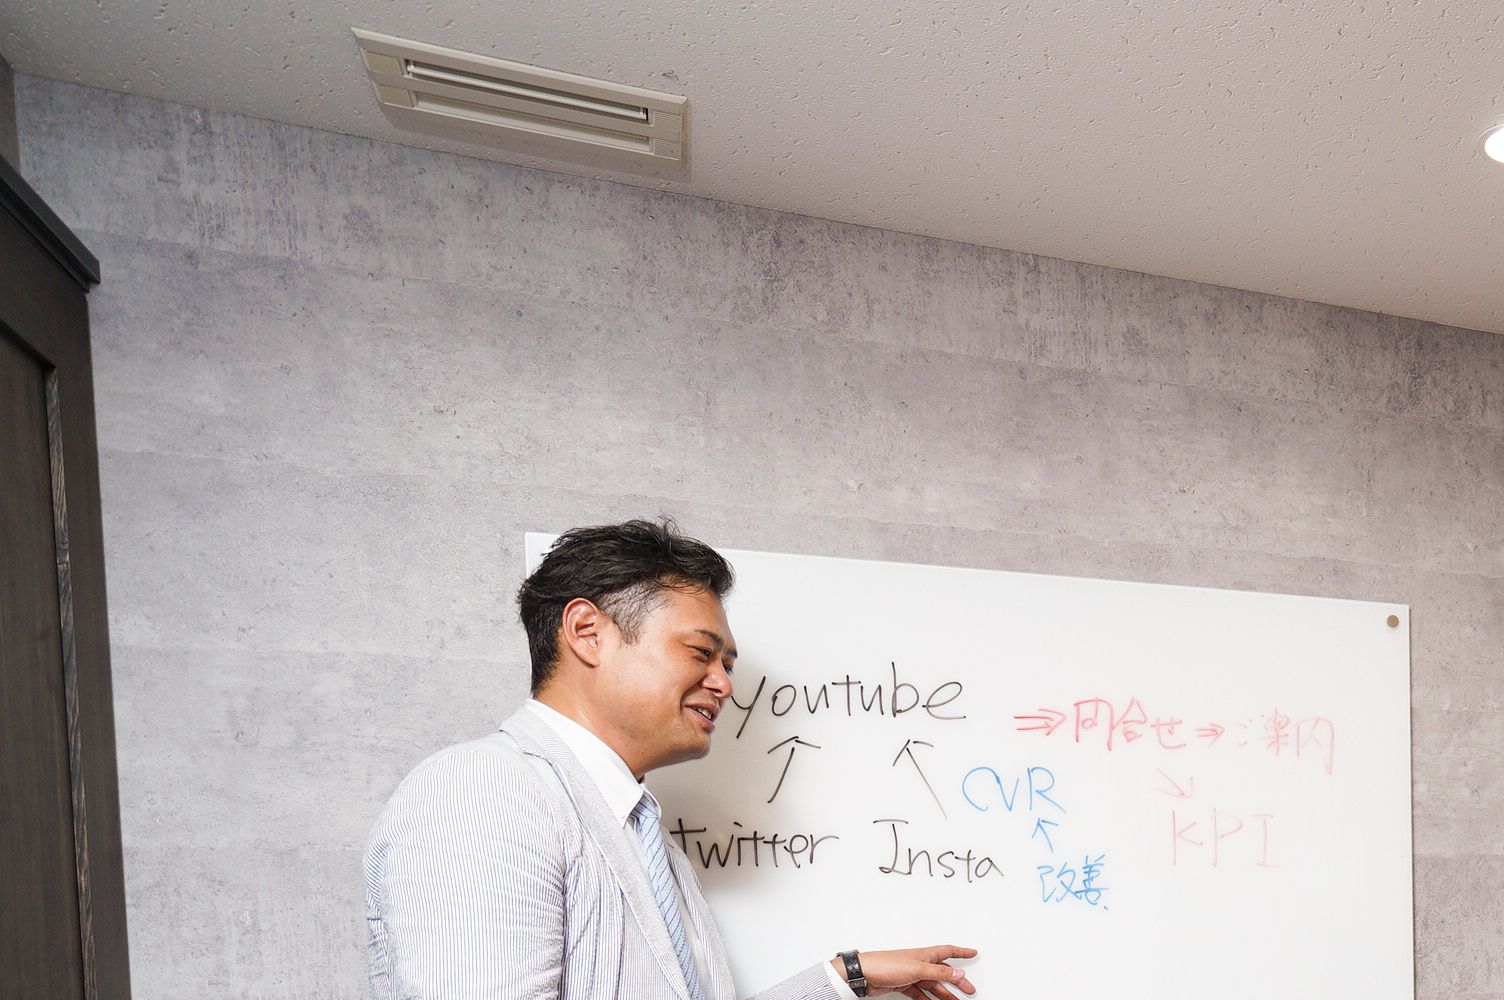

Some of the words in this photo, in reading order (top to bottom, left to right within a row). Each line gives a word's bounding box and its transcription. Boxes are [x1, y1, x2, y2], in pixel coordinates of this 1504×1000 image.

[961, 766, 1066, 813] CVR
[669, 818, 840, 869] twitter
[872, 818, 1004, 883] Insta
[1168, 807, 1284, 868] KPI
